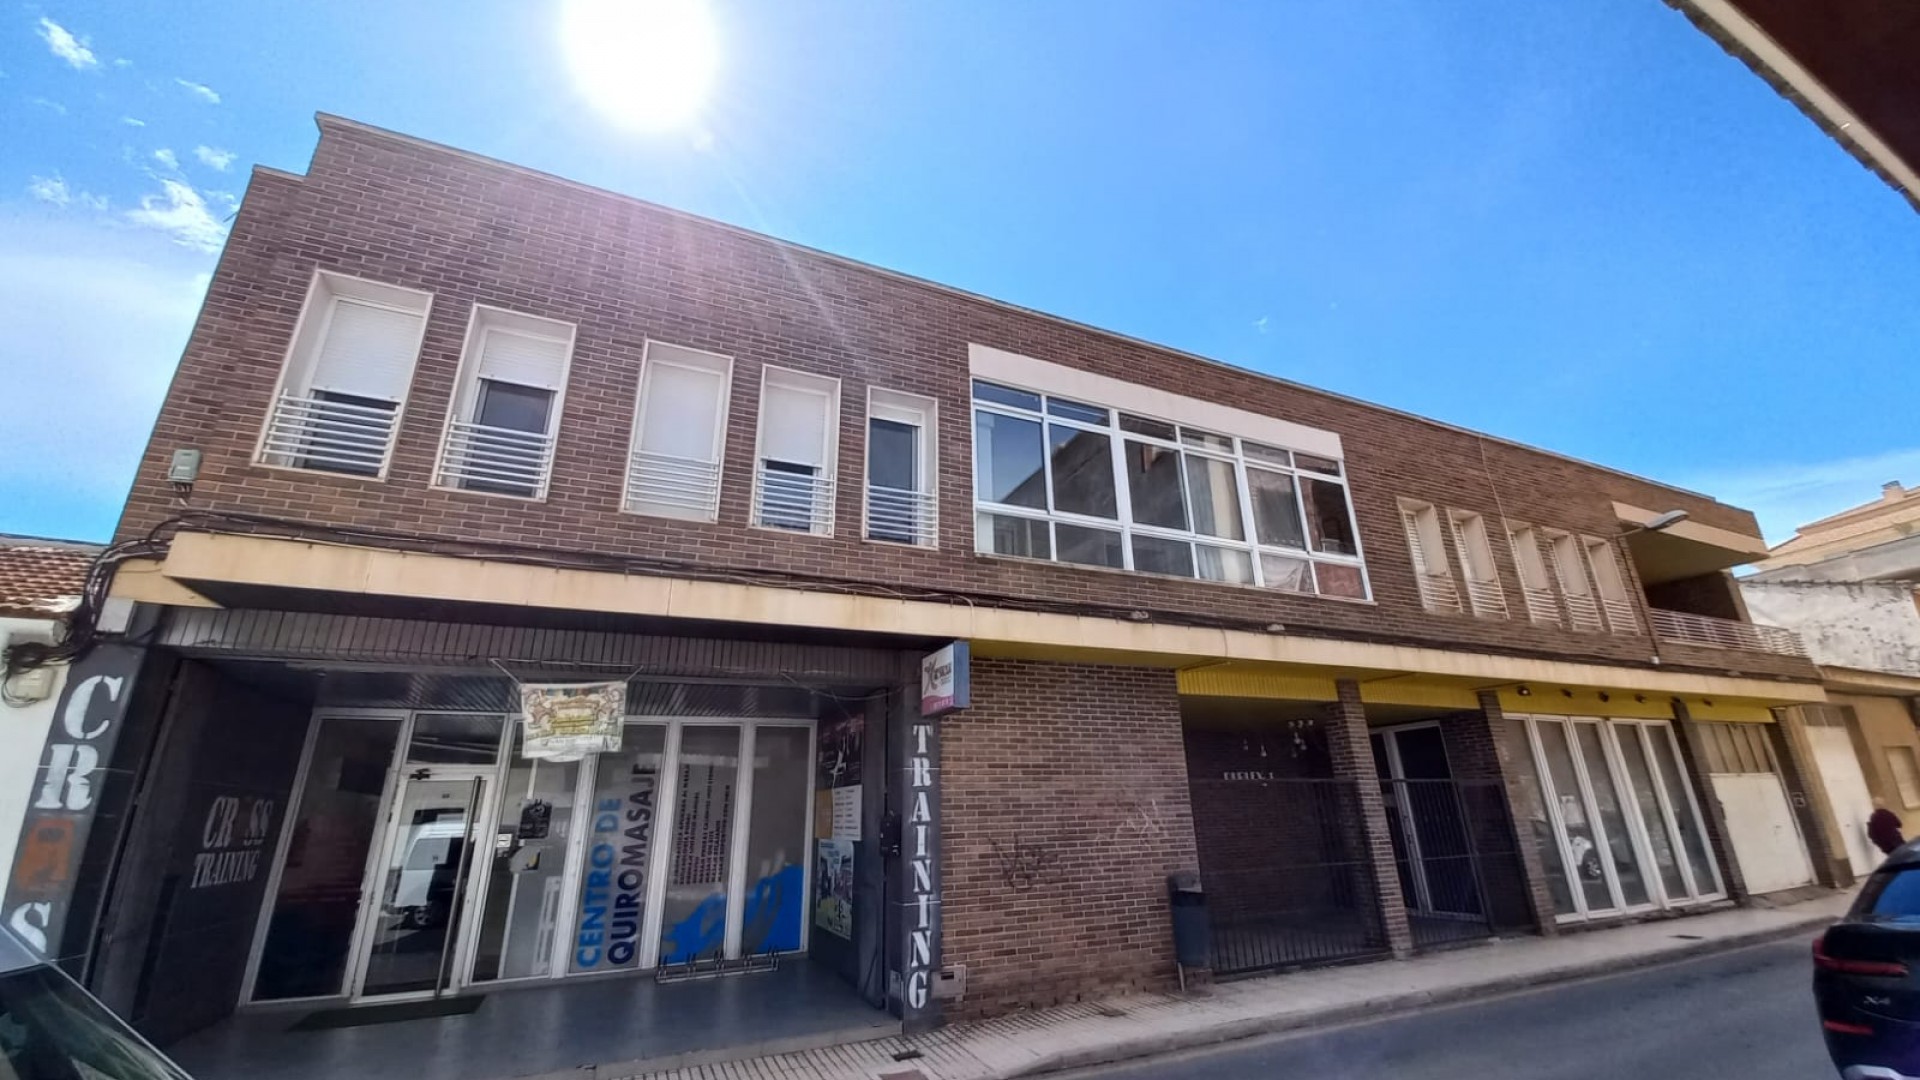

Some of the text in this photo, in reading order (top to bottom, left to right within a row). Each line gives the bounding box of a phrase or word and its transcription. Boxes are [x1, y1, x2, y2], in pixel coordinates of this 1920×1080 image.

[191, 850, 260, 889] TRAINING
[576, 797, 622, 968] CENTRO DE
[607, 762, 656, 965] QUIROMASAJE
[908, 724, 933, 1009] TRAINING
